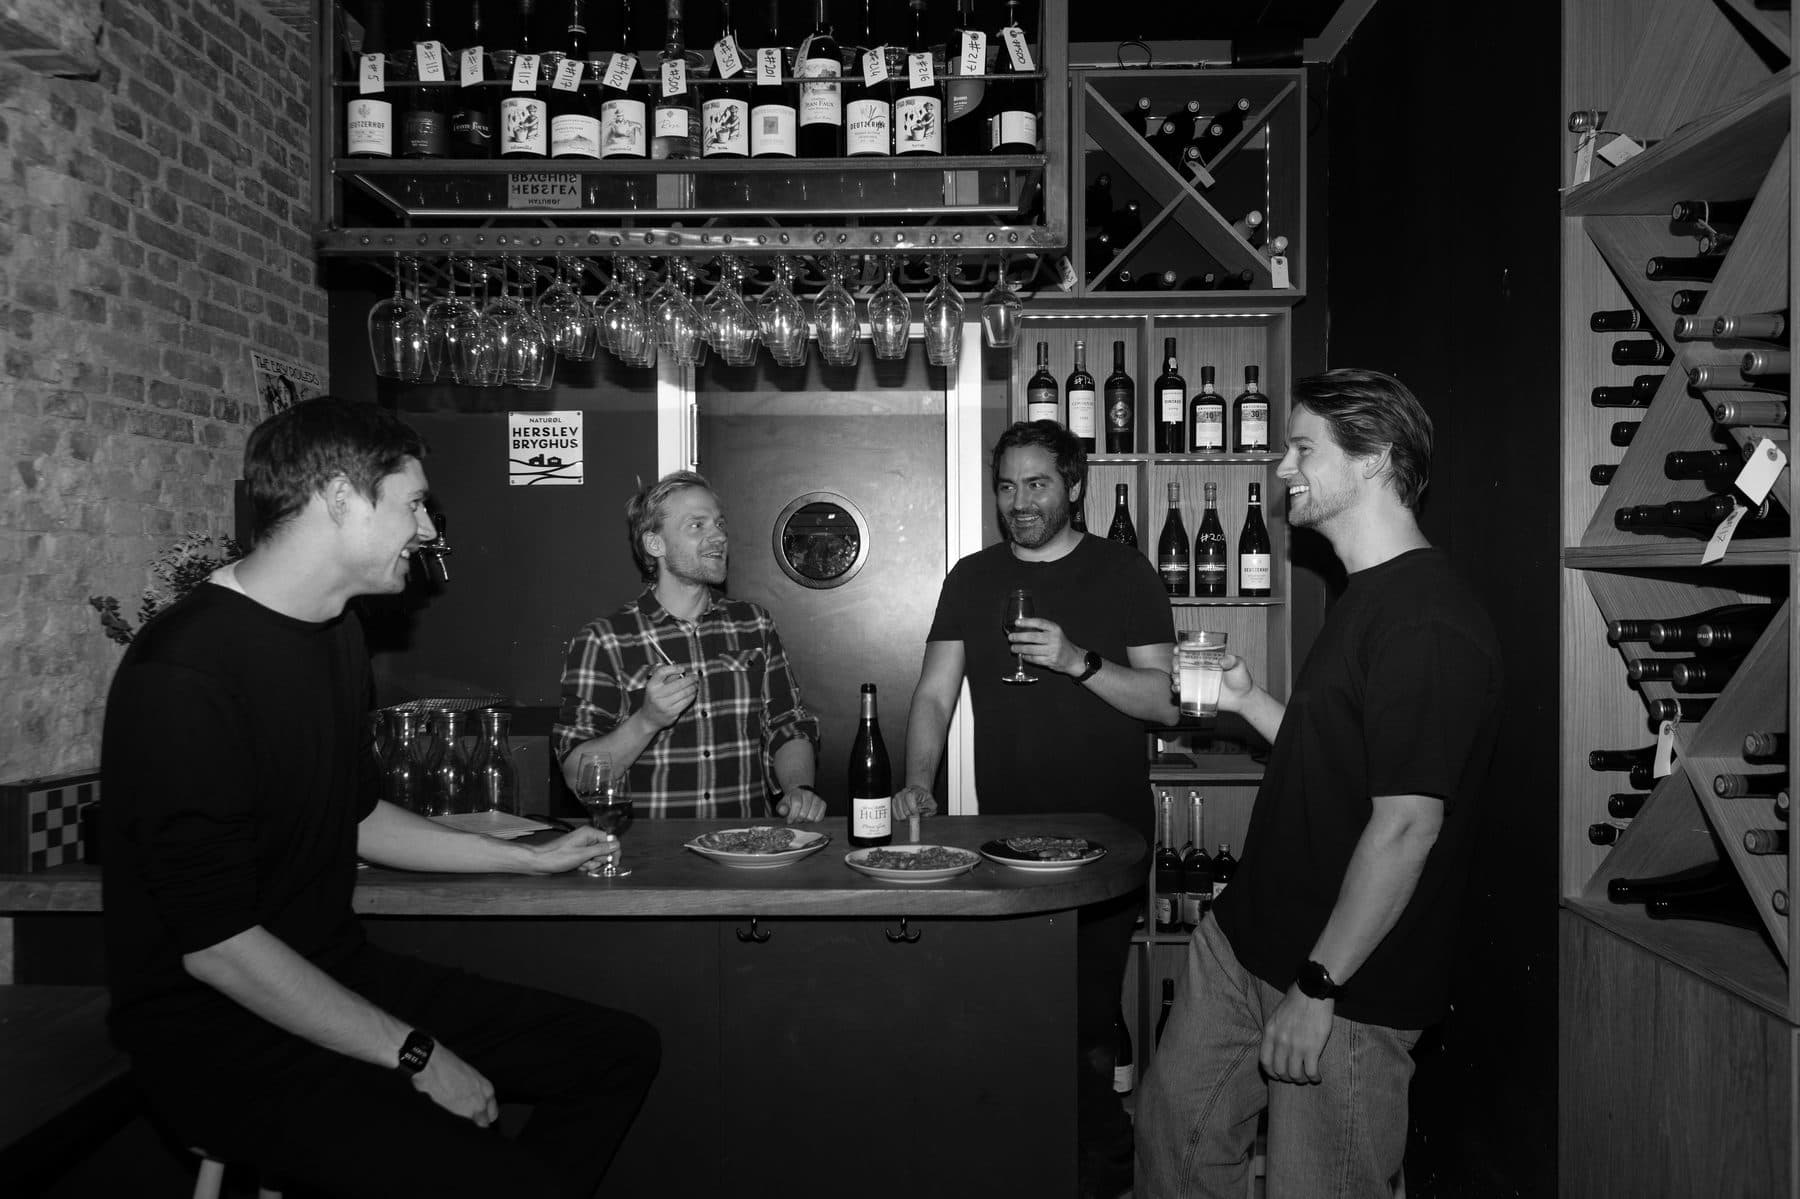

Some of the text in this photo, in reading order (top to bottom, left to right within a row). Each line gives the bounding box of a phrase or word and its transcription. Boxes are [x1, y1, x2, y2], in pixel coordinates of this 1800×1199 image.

[764, 56, 777, 78] #201
[967, 41, 981, 72] #217
[518, 62, 534, 85] #115
[610, 61, 630, 87] #402
[667, 69, 681, 93] #300
[512, 427, 578, 437] HERSLEV
[512, 439, 578, 449] BRYGHUS
